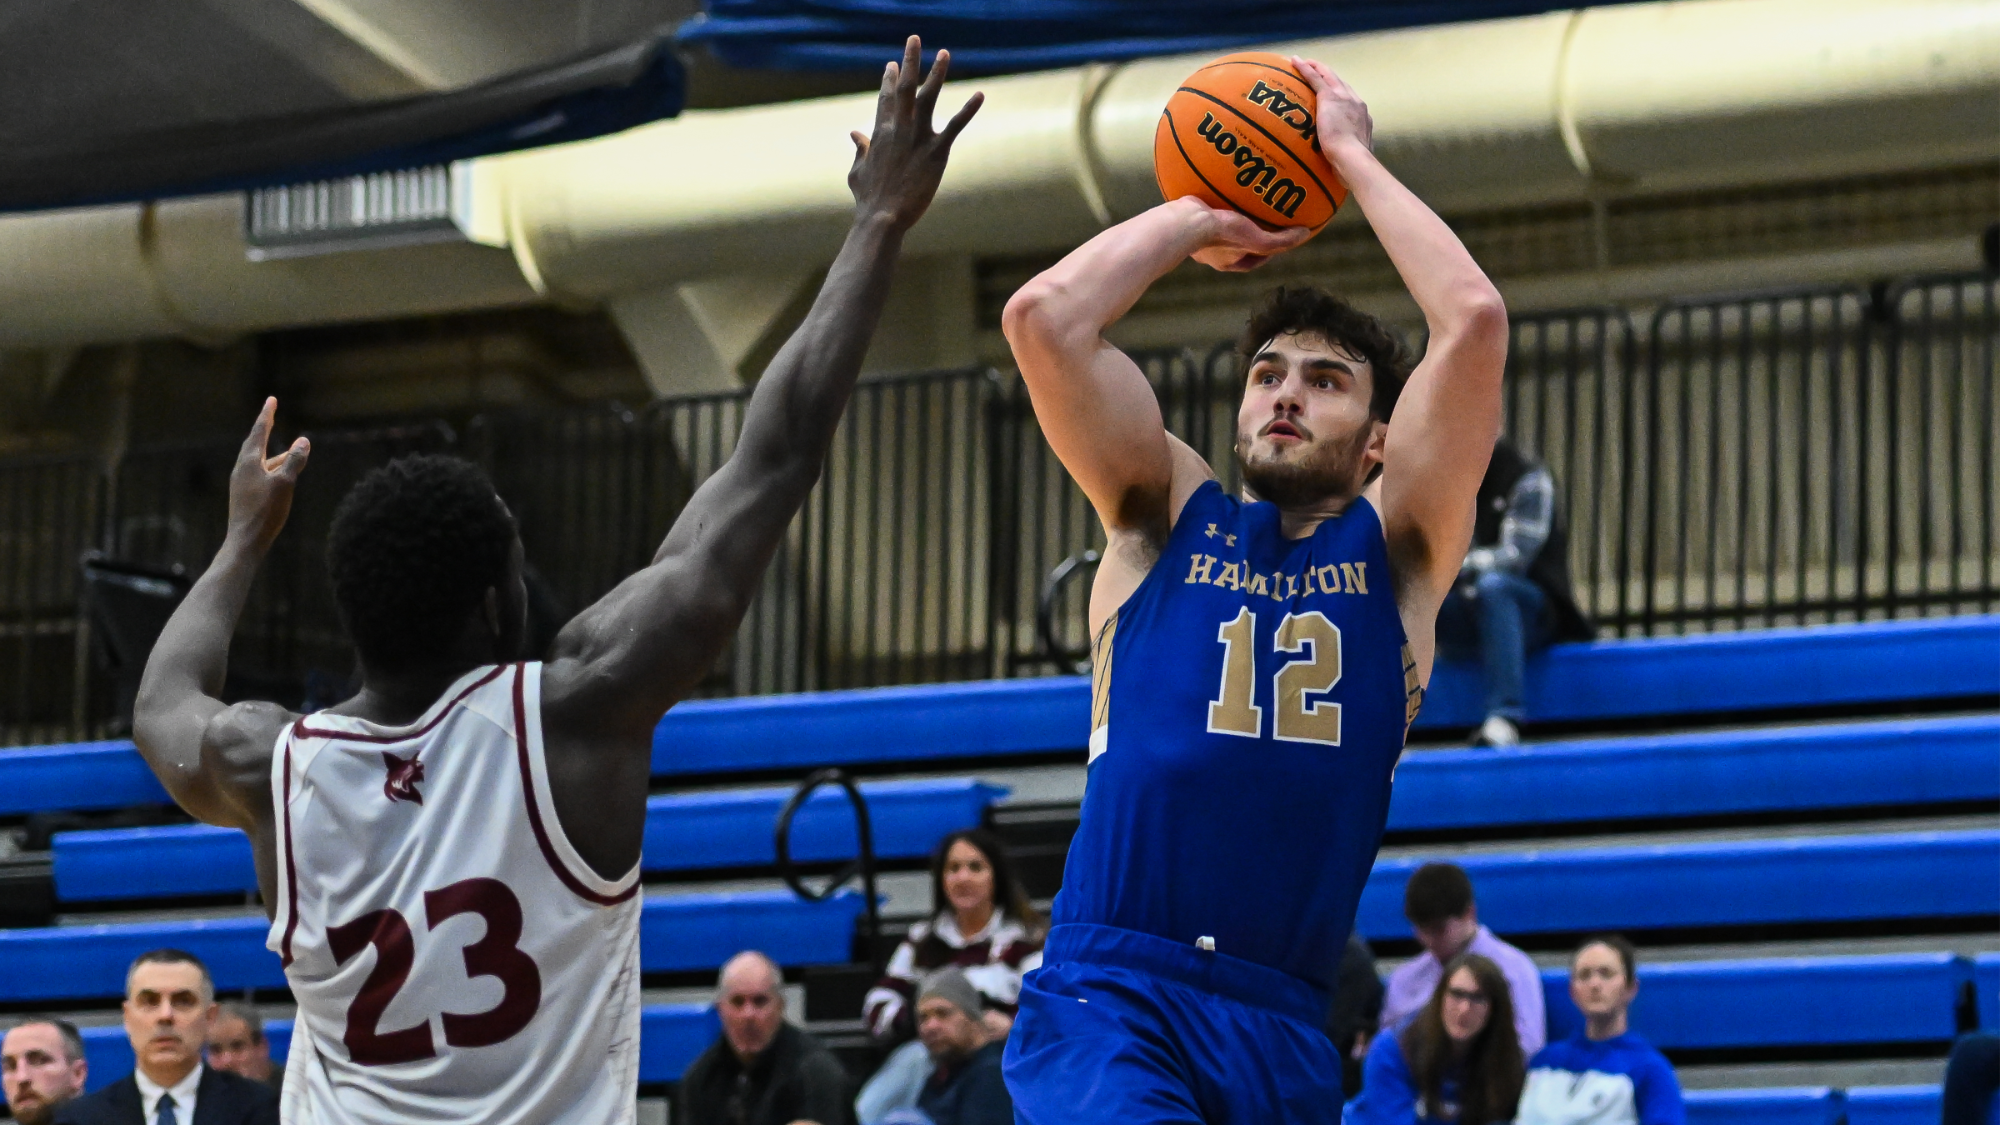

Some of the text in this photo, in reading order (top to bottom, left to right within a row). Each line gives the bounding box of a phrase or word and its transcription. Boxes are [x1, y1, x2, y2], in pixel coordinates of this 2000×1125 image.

[1197, 110, 1307, 219] Wilson
[1184, 553, 1369, 602] HAMILTON
[1207, 605, 1342, 747] 12
[326, 876, 542, 1067] 23
